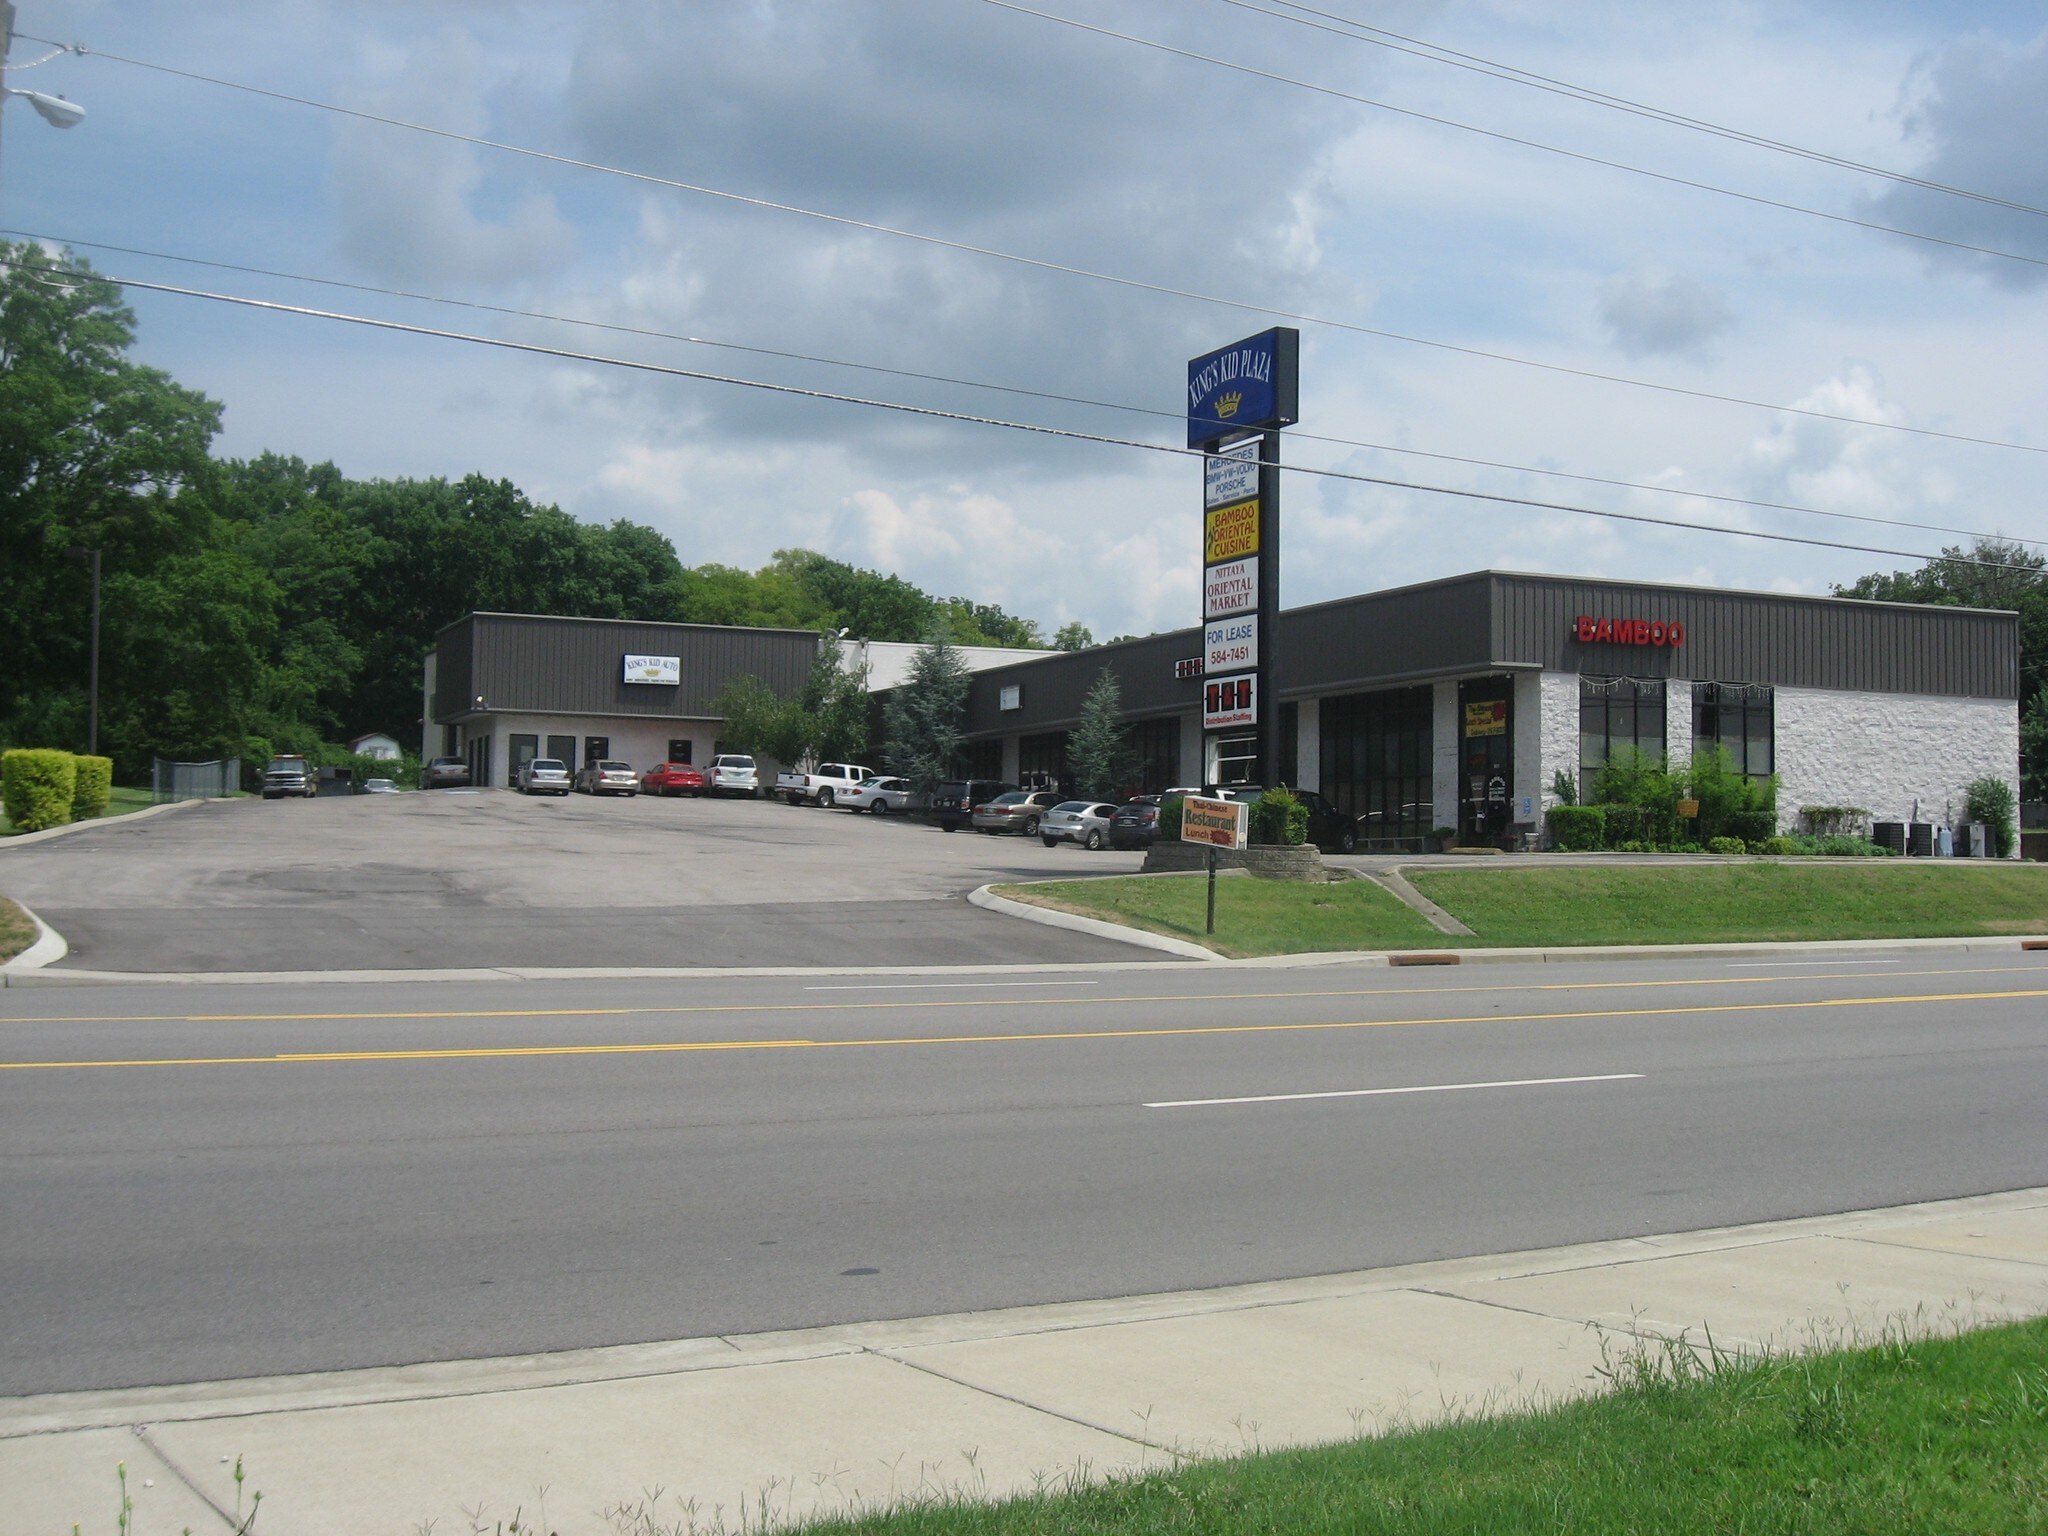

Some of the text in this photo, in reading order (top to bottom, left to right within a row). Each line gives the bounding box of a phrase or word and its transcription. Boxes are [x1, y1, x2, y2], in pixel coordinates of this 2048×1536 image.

[1189, 349, 1271, 408] KING'S KID PLAZA
[1209, 448, 1254, 470] MERCEDES
[1215, 476, 1247, 495] PORSCHE
[1215, 505, 1255, 528] BAMBOO
[1213, 520, 1256, 543] ORIENTAL
[1213, 535, 1252, 557] CUISINE
[1215, 563, 1246, 579] NITTAYA
[1207, 577, 1254, 598] ORIENTAL
[1210, 592, 1250, 612] MARKET
[1207, 624, 1253, 645] FOR LEASE
[1576, 615, 1685, 647] BAMBOO
[649, 658, 660, 666] KID
[662, 660, 678, 671] AUTO
[1211, 646, 1249, 665] 584-7451
[1185, 809, 1236, 831] Restaurant
[1186, 828, 1209, 839] Lunch
